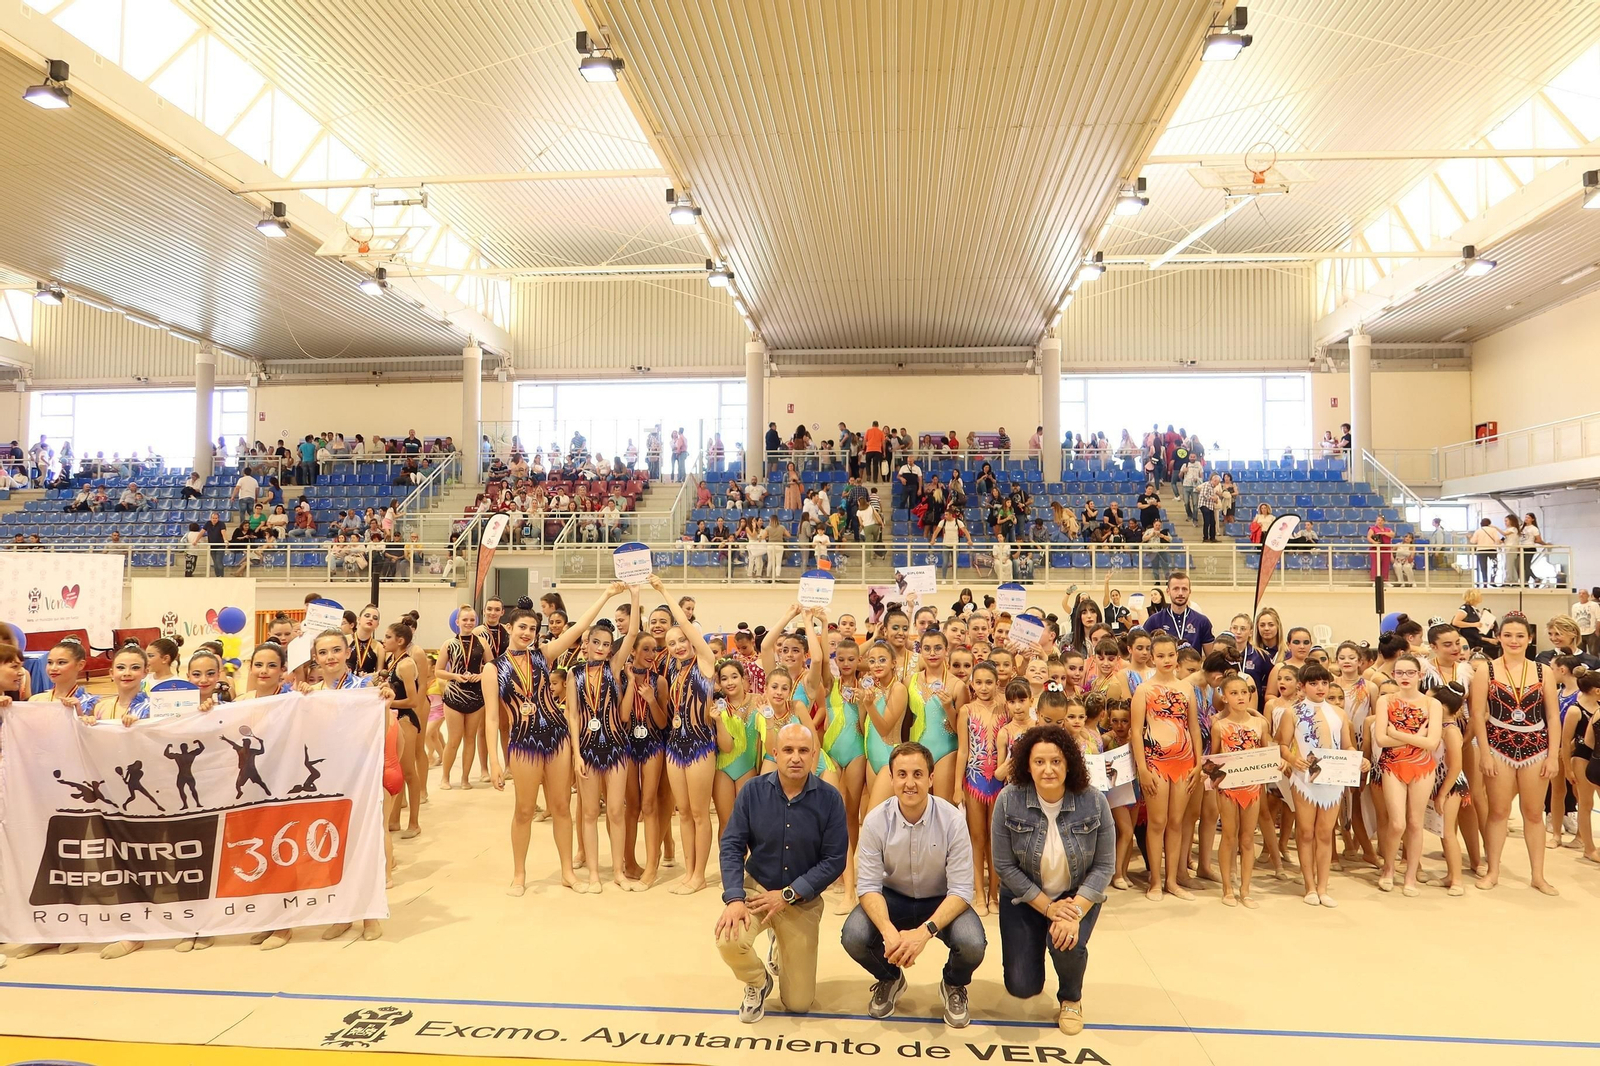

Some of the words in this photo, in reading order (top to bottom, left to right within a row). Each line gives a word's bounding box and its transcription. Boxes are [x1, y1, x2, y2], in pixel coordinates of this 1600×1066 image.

[45, 596, 70, 610] Vera
[184, 621, 216, 636] Vera
[1228, 762, 1278, 774] BALANEGRA
[58, 838, 203, 860] CENTRO
[227, 818, 340, 882] 360
[49, 869, 203, 886] DEPORTIVO
[34, 907, 194, 926] Roquetas
[224, 903, 256, 915] de
[284, 894, 336, 909] Mar
[414, 1020, 567, 1042] Excmo.
[581, 1026, 882, 1056] Ayuntamiento
[898, 1041, 950, 1059] de
[964, 1043, 1112, 1066] VERA
